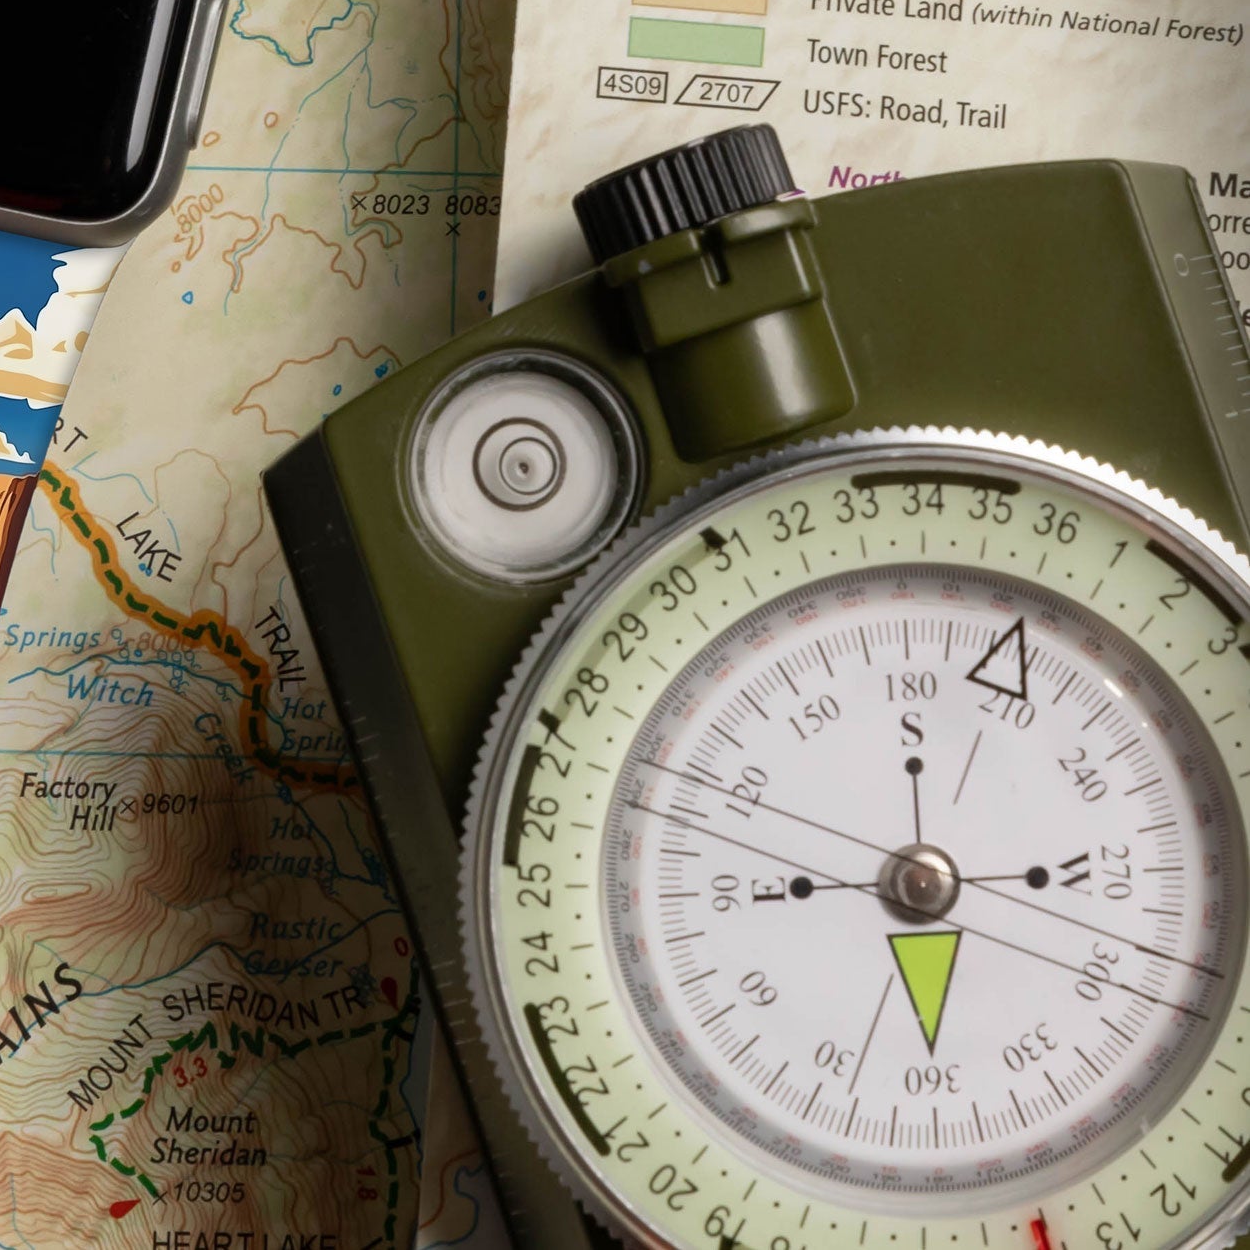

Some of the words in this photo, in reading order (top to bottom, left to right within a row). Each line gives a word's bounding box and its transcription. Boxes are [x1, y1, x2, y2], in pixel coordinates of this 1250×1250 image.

[973, 3, 1052, 27] (within
[1061, 11, 1160, 35] National
[1166, 20, 1243, 46] Forest)
[808, 39, 867, 66] Town
[878, 45, 947, 73] Forest
[604, 73, 662, 97] 4S09
[700, 82, 754, 103] 2707
[804, 90, 870, 117] USFS:
[881, 96, 947, 128] Road,
[957, 102, 1006, 128] Trail
[372, 195, 429, 216] 8023
[445, 195, 501, 216] 8083
[901, 485, 944, 516] 34
[767, 501, 815, 541] 32
[1033, 503, 1081, 543] 36
[114, 510, 183, 583] LAKE
[650, 565, 697, 611] 30
[1159, 578, 1190, 610] 2
[4, 625, 102, 653] Springs
[254, 605, 307, 693] TRAIL
[602, 613, 649, 662] 29
[65, 675, 154, 708] Witch
[886, 672, 937, 702] 180
[901, 712, 924, 747] S
[19, 771, 117, 805] Factory
[1058, 747, 1107, 802] 240
[69, 806, 116, 834] Hill
[142, 793, 198, 816] 9601
[517, 863, 552, 907] 25
[1057, 853, 1093, 895] W
[1101, 845, 1133, 900] 270
[752, 877, 787, 903] E
[525, 931, 560, 976] 24
[67, 1014, 154, 1112] MOUNT
[162, 983, 321, 1030] SHERIDAN
[1003, 1022, 1057, 1072] 330
[904, 1064, 961, 1095] 360
[166, 1107, 257, 1135] Mount
[150, 1138, 269, 1167] Sheridan
[173, 1183, 245, 1203] 10305
[649, 1165, 699, 1211] 20
